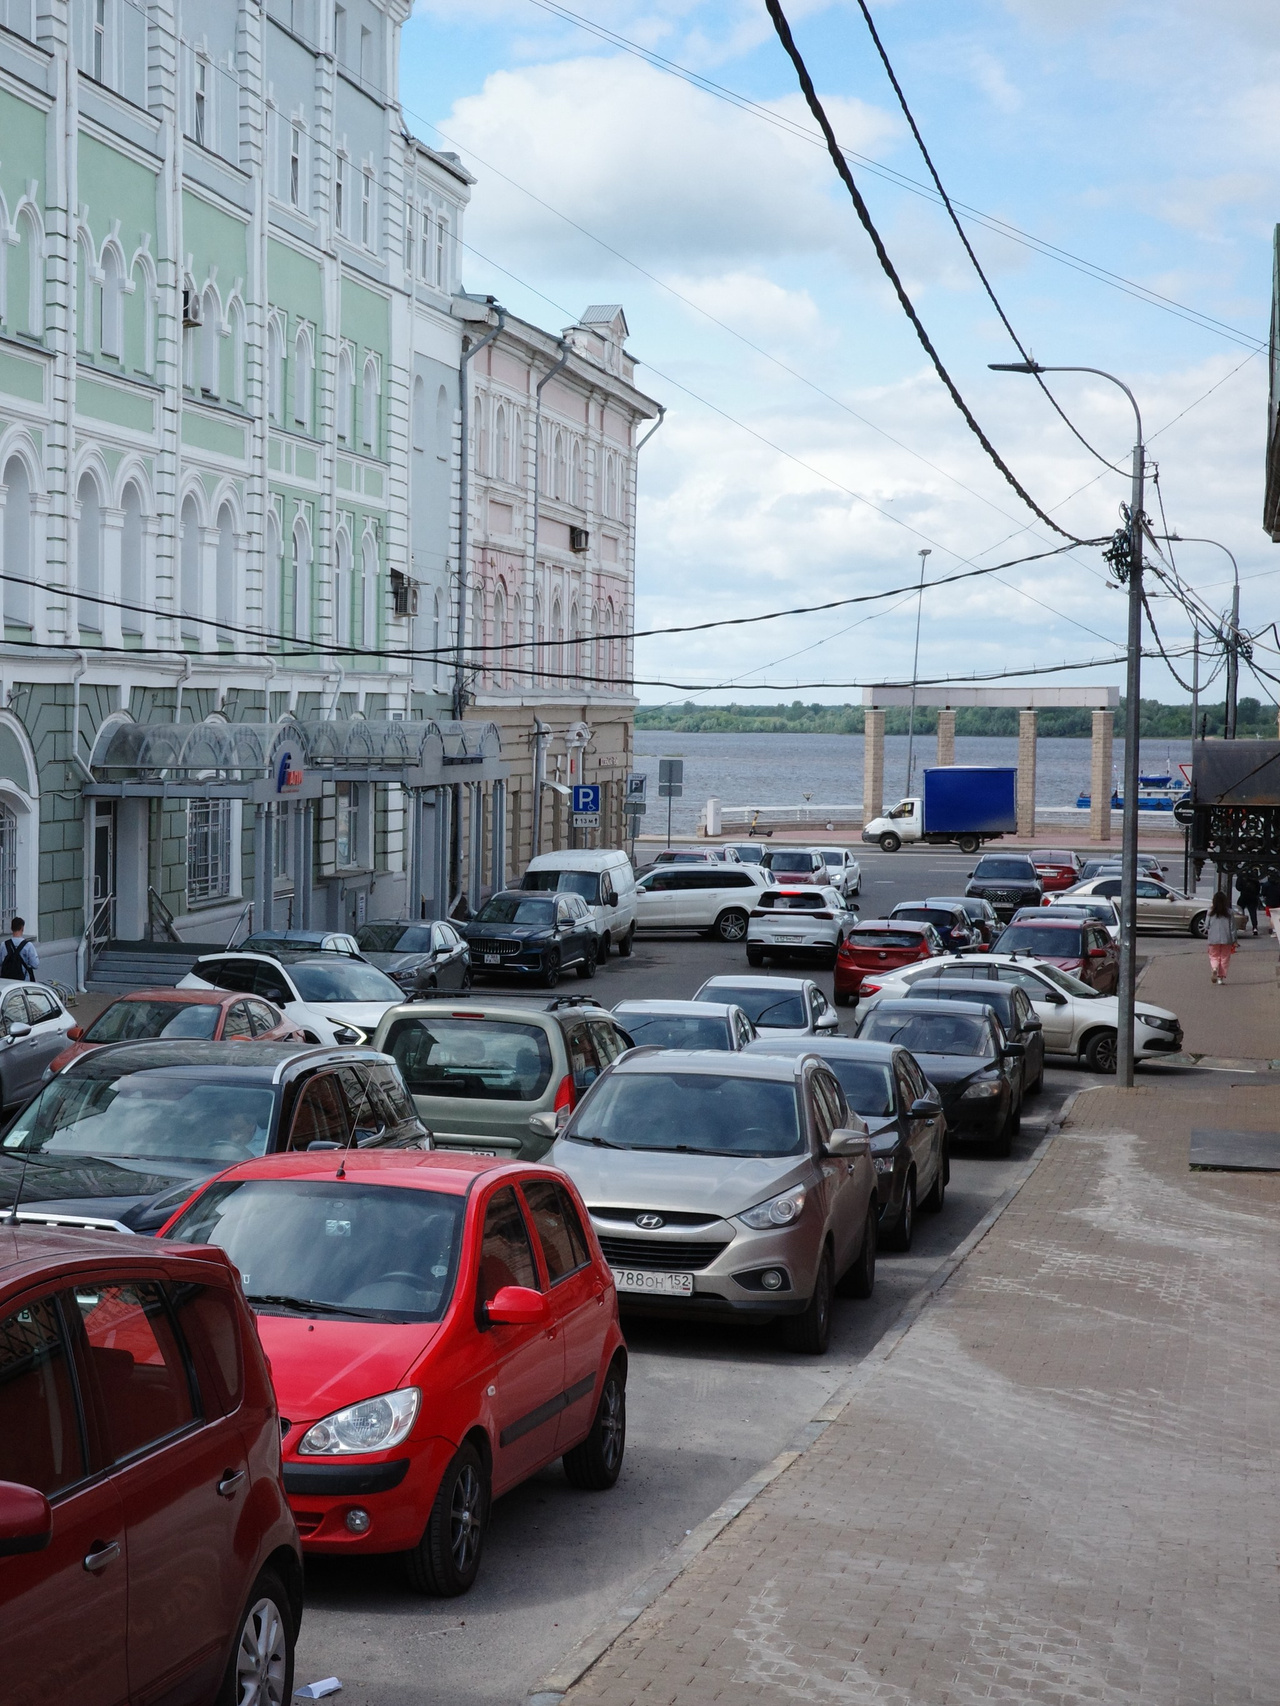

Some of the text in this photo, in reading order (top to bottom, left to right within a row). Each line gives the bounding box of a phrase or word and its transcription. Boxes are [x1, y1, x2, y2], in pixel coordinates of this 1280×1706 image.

[579, 788, 594, 809] P
[617, 1271, 689, 1288] 788ОН 152
